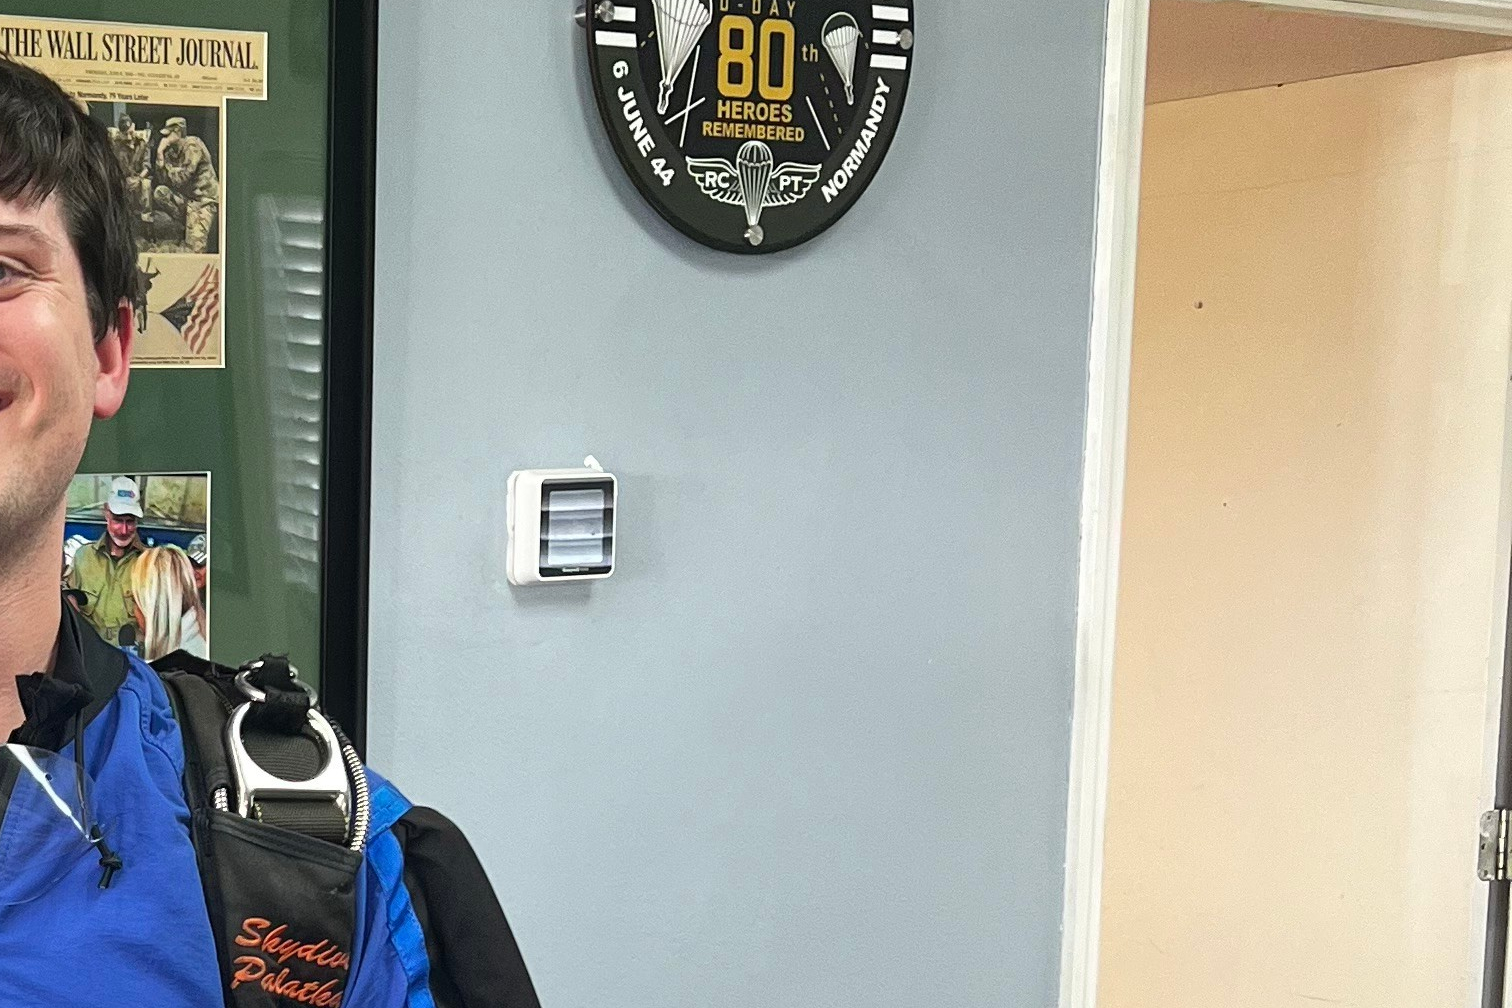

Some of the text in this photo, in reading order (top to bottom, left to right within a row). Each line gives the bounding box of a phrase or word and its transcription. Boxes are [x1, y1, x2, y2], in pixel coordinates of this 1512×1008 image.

[1, 26, 260, 71] THE WALL STREET JOURNAL.
[717, 15, 819, 101] 80 th
[613, 60, 676, 187] 6 JUNE 44
[702, 121, 805, 142] REMEMBERED
[716, 100, 793, 123] HEROES
[820, 76, 891, 203] NORMANDY
[705, 172, 731, 190] RC
[779, 175, 803, 193] PT
[235, 917, 350, 971] Skydiv
